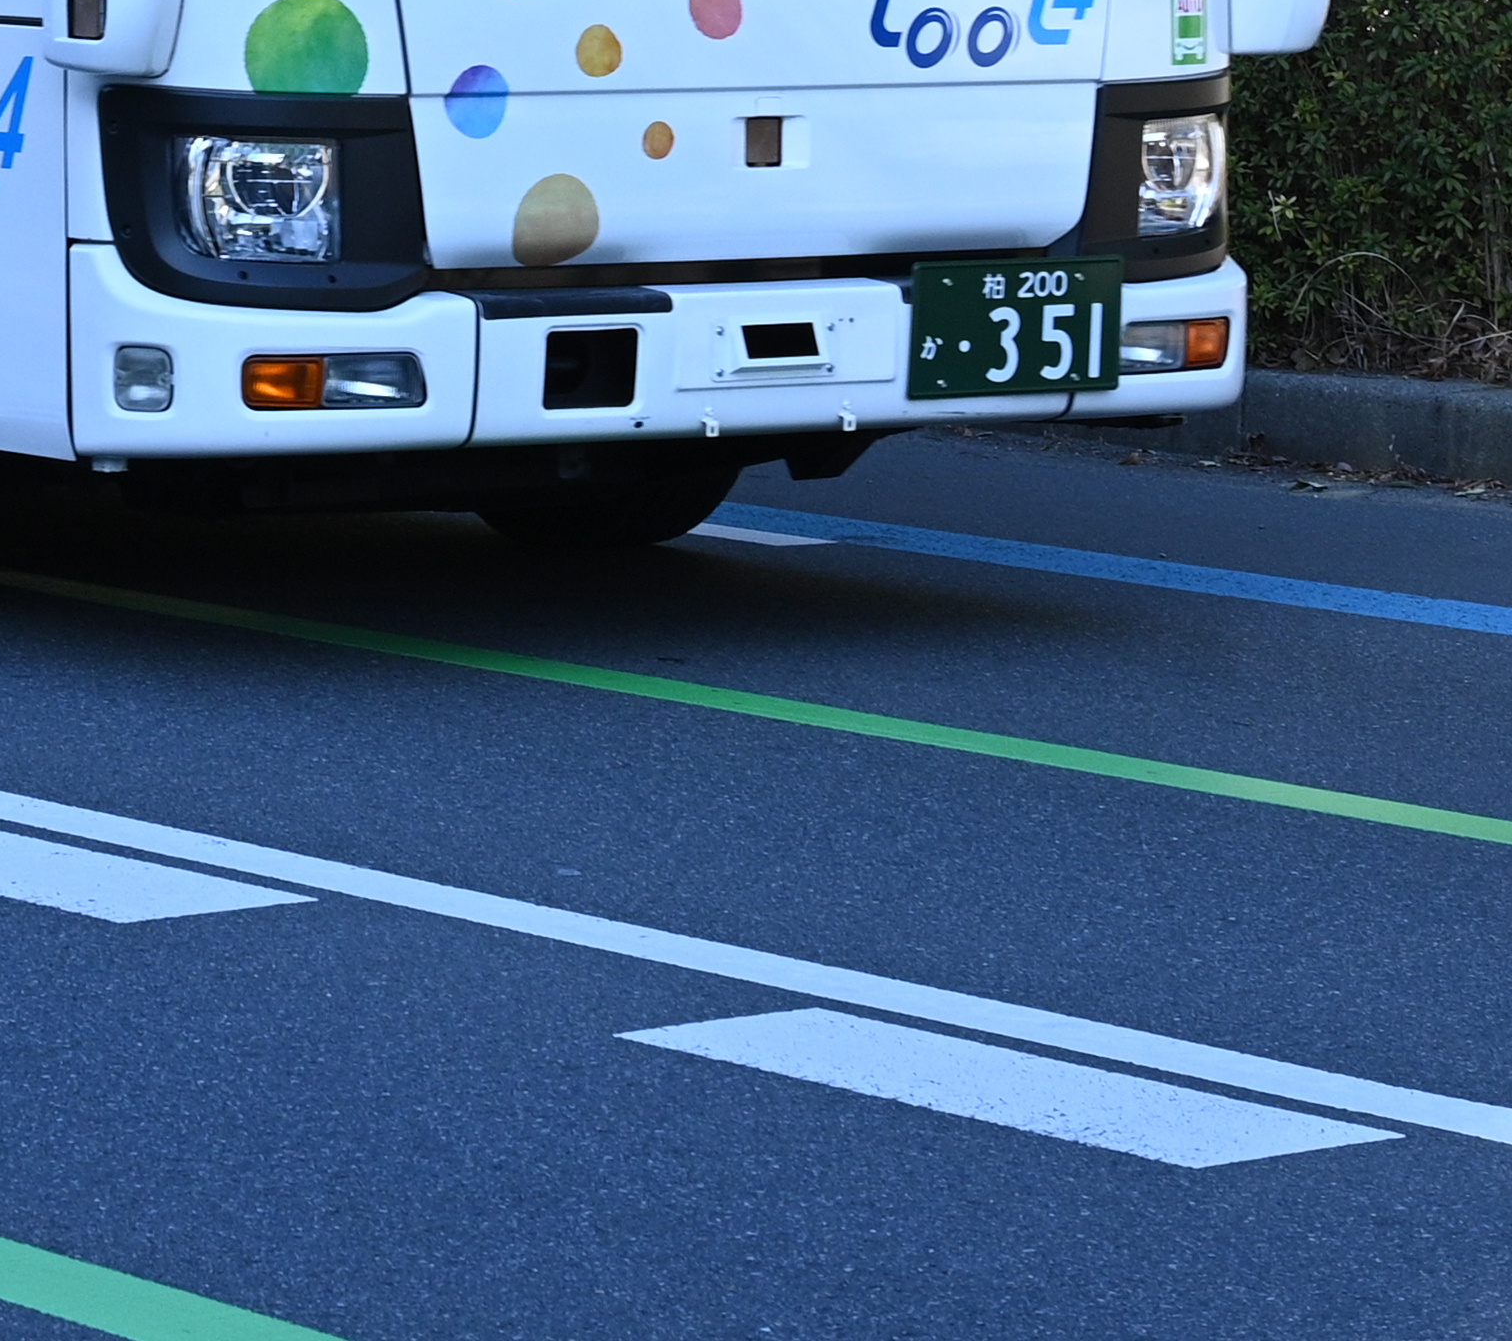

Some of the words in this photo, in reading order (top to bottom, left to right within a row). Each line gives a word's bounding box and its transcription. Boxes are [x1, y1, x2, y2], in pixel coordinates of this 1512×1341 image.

[982, 274, 1006, 299] 柏
[1017, 270, 1068, 298] 200
[920, 335, 943, 360] か
